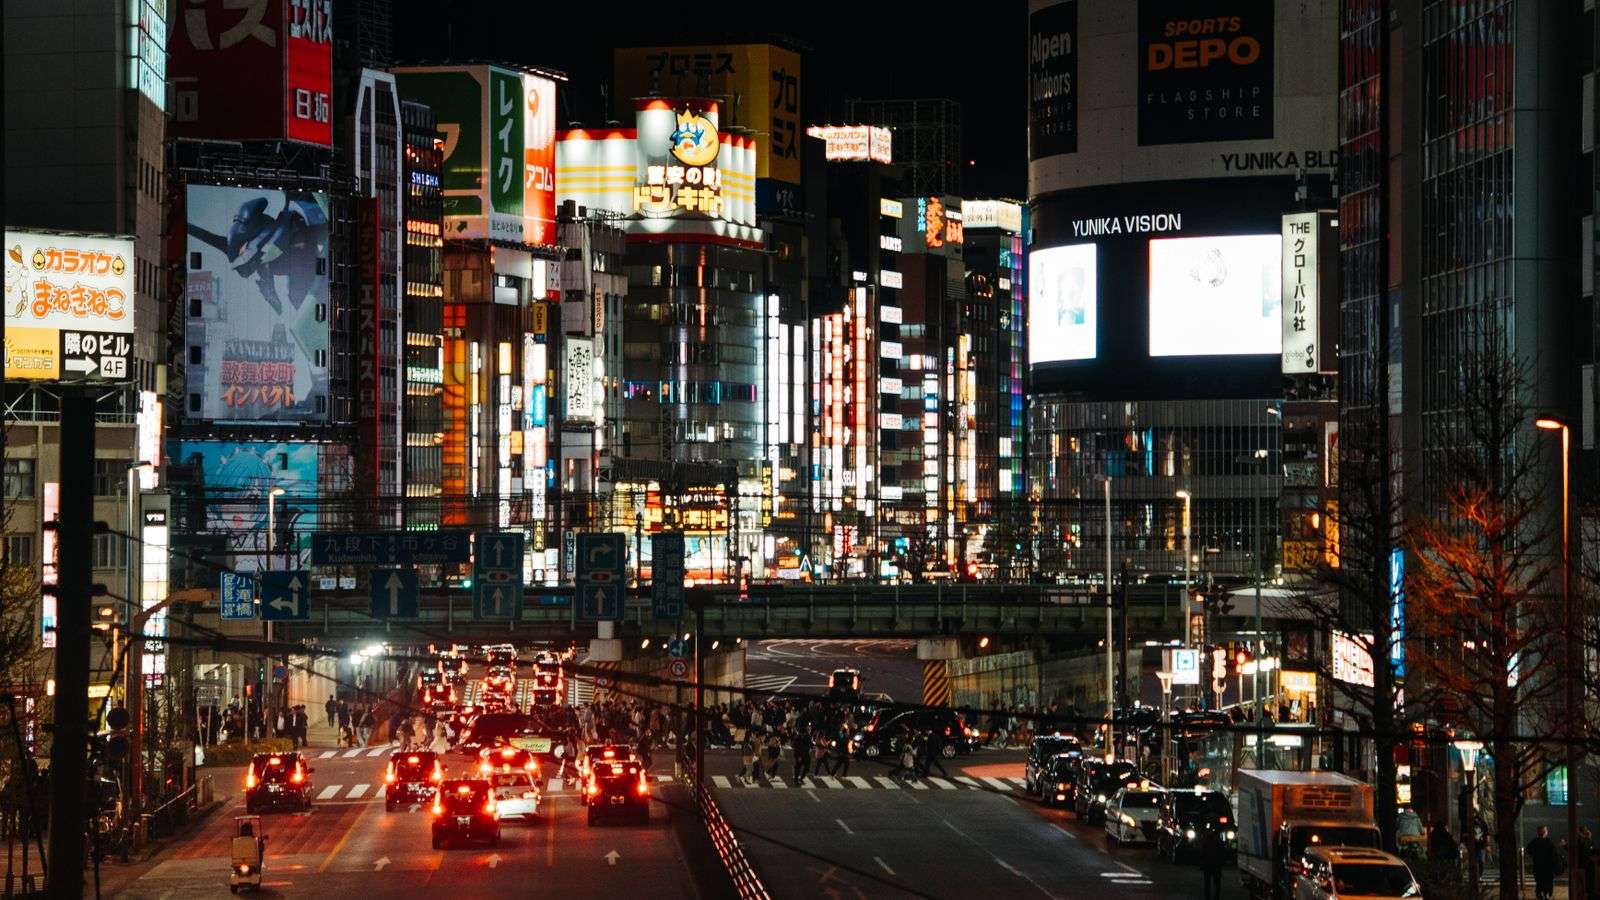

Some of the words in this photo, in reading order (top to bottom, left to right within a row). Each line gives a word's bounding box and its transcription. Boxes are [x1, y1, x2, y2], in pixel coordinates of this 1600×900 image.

[1164, 16, 1242, 37] SPORTS
[1031, 31, 1072, 68] Alpen
[1147, 35, 1261, 72] DEPO
[646, 52, 737, 76] プロミス
[296, 88, 329, 123] 日拓
[1147, 86, 1262, 105] FLAGSHIP
[1187, 105, 1262, 120] STORE
[498, 79, 514, 194] レイク
[1220, 152, 1299, 172] YUNIKA
[411, 171, 440, 186] SHISHA
[525, 164, 554, 192] アコム
[1072, 217, 1122, 237] YUNIKA
[1124, 213, 1182, 233] VISION
[1289, 221, 1311, 234] THE
[45, 247, 113, 275] カラオケ
[1293, 238, 1307, 332] グローバル社
[31, 277, 126, 319] まねきねこ
[64, 332, 130, 356] 隣のビル
[103, 359, 123, 375] 4F
[222, 384, 297, 407] インパクト
[323, 535, 382, 553] 九段下
